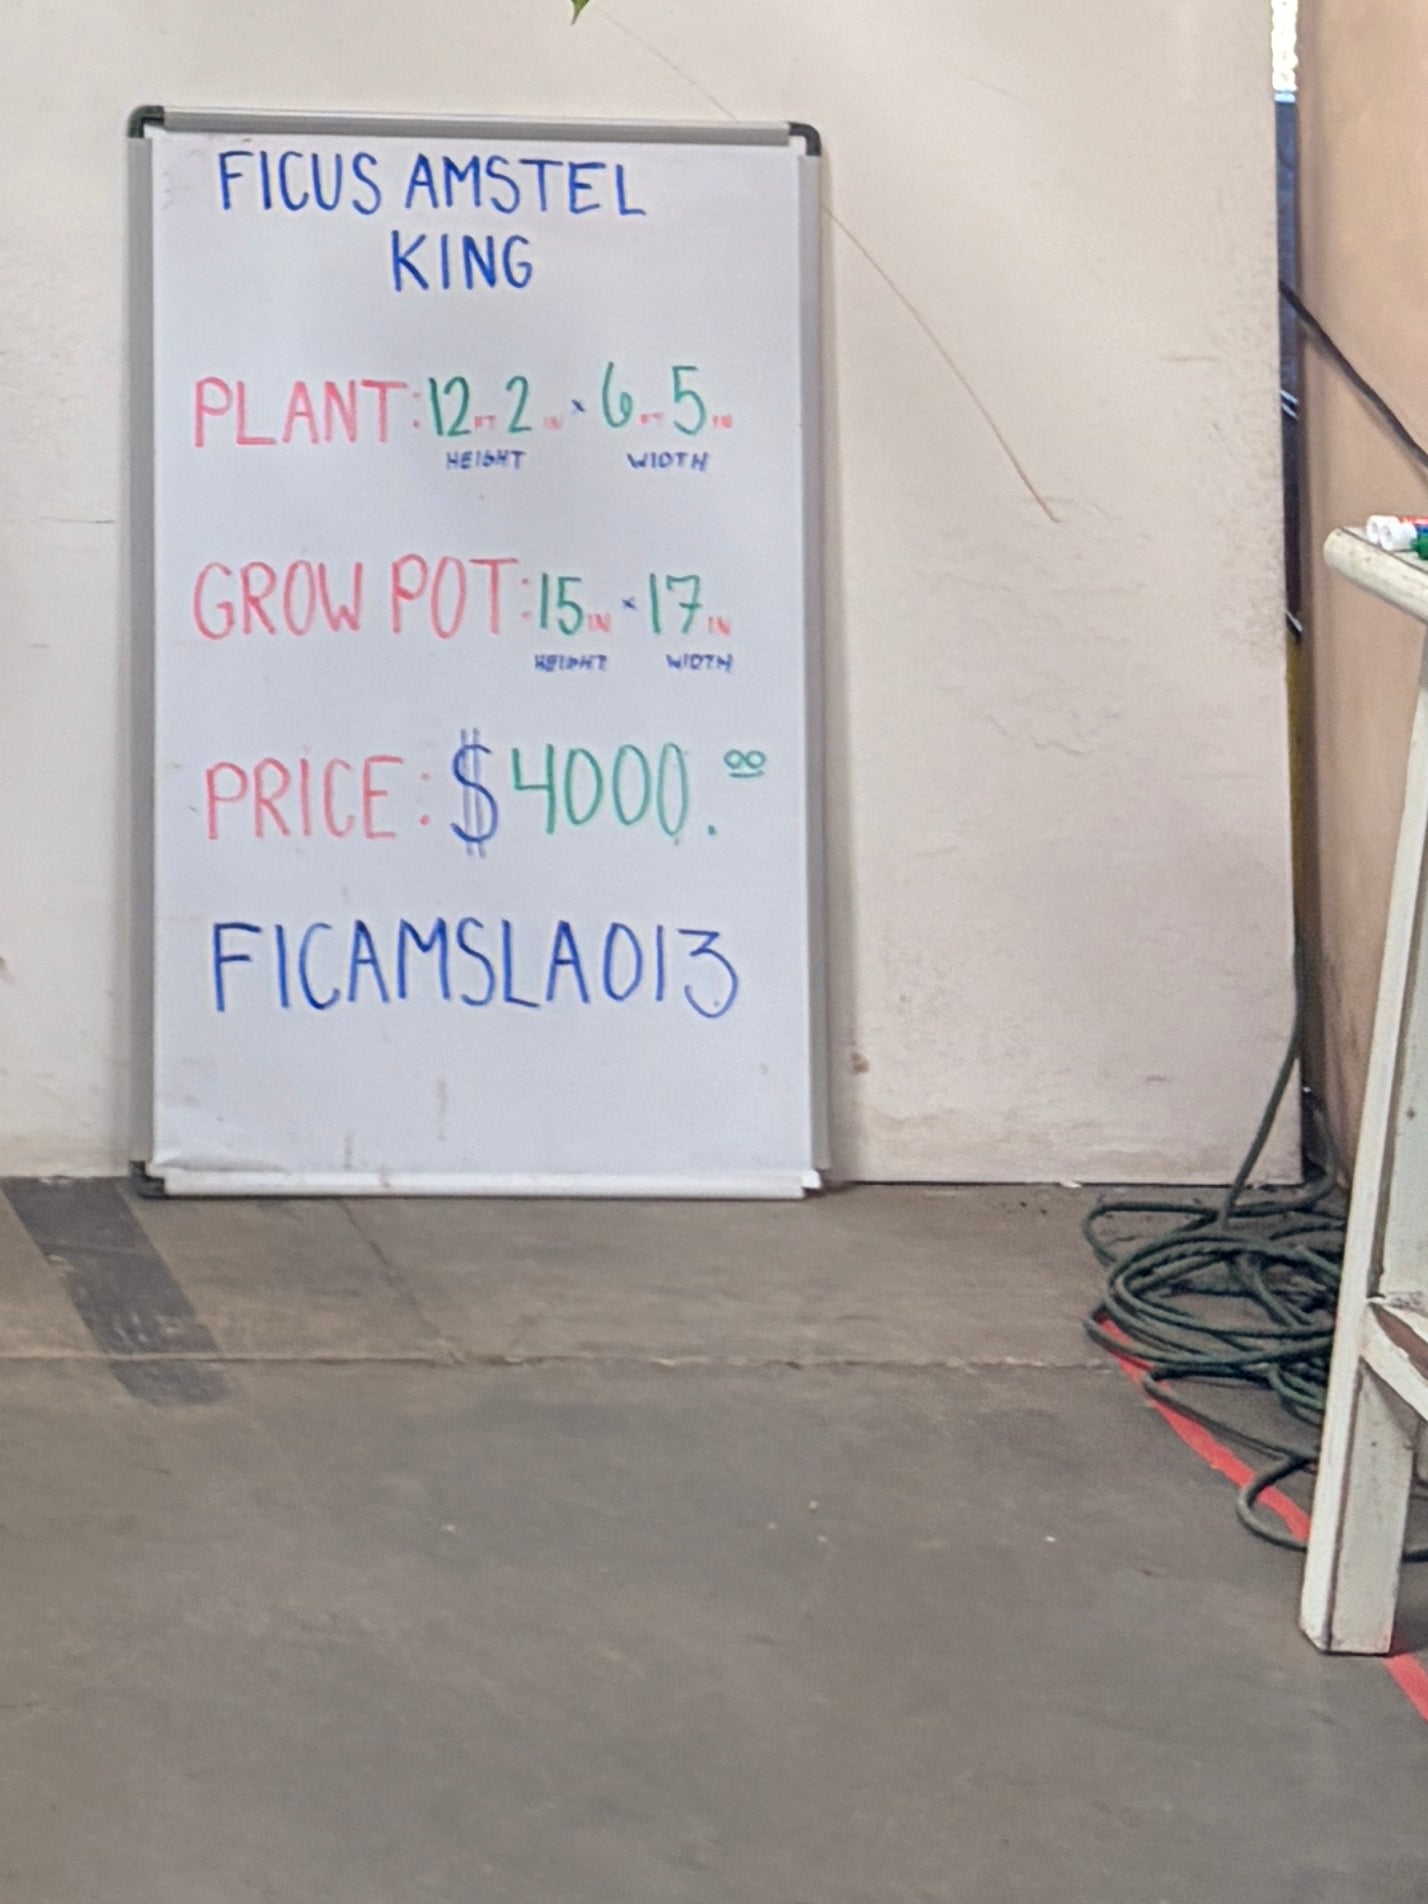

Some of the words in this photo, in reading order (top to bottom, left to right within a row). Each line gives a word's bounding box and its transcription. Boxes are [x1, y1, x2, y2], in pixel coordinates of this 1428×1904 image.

[217, 149, 384, 215] FICUS
[403, 152, 648, 217] AMSTEL
[390, 229, 535, 293] KING
[193, 376, 423, 448] PLANT:
[445, 449, 527, 470] HEIGHT
[626, 451, 710, 472] WIDTH
[193, 561, 365, 641] GROW
[391, 553, 533, 640] POT:
[665, 653, 735, 673] WIDTH
[204, 754, 432, 840] PRICE:
